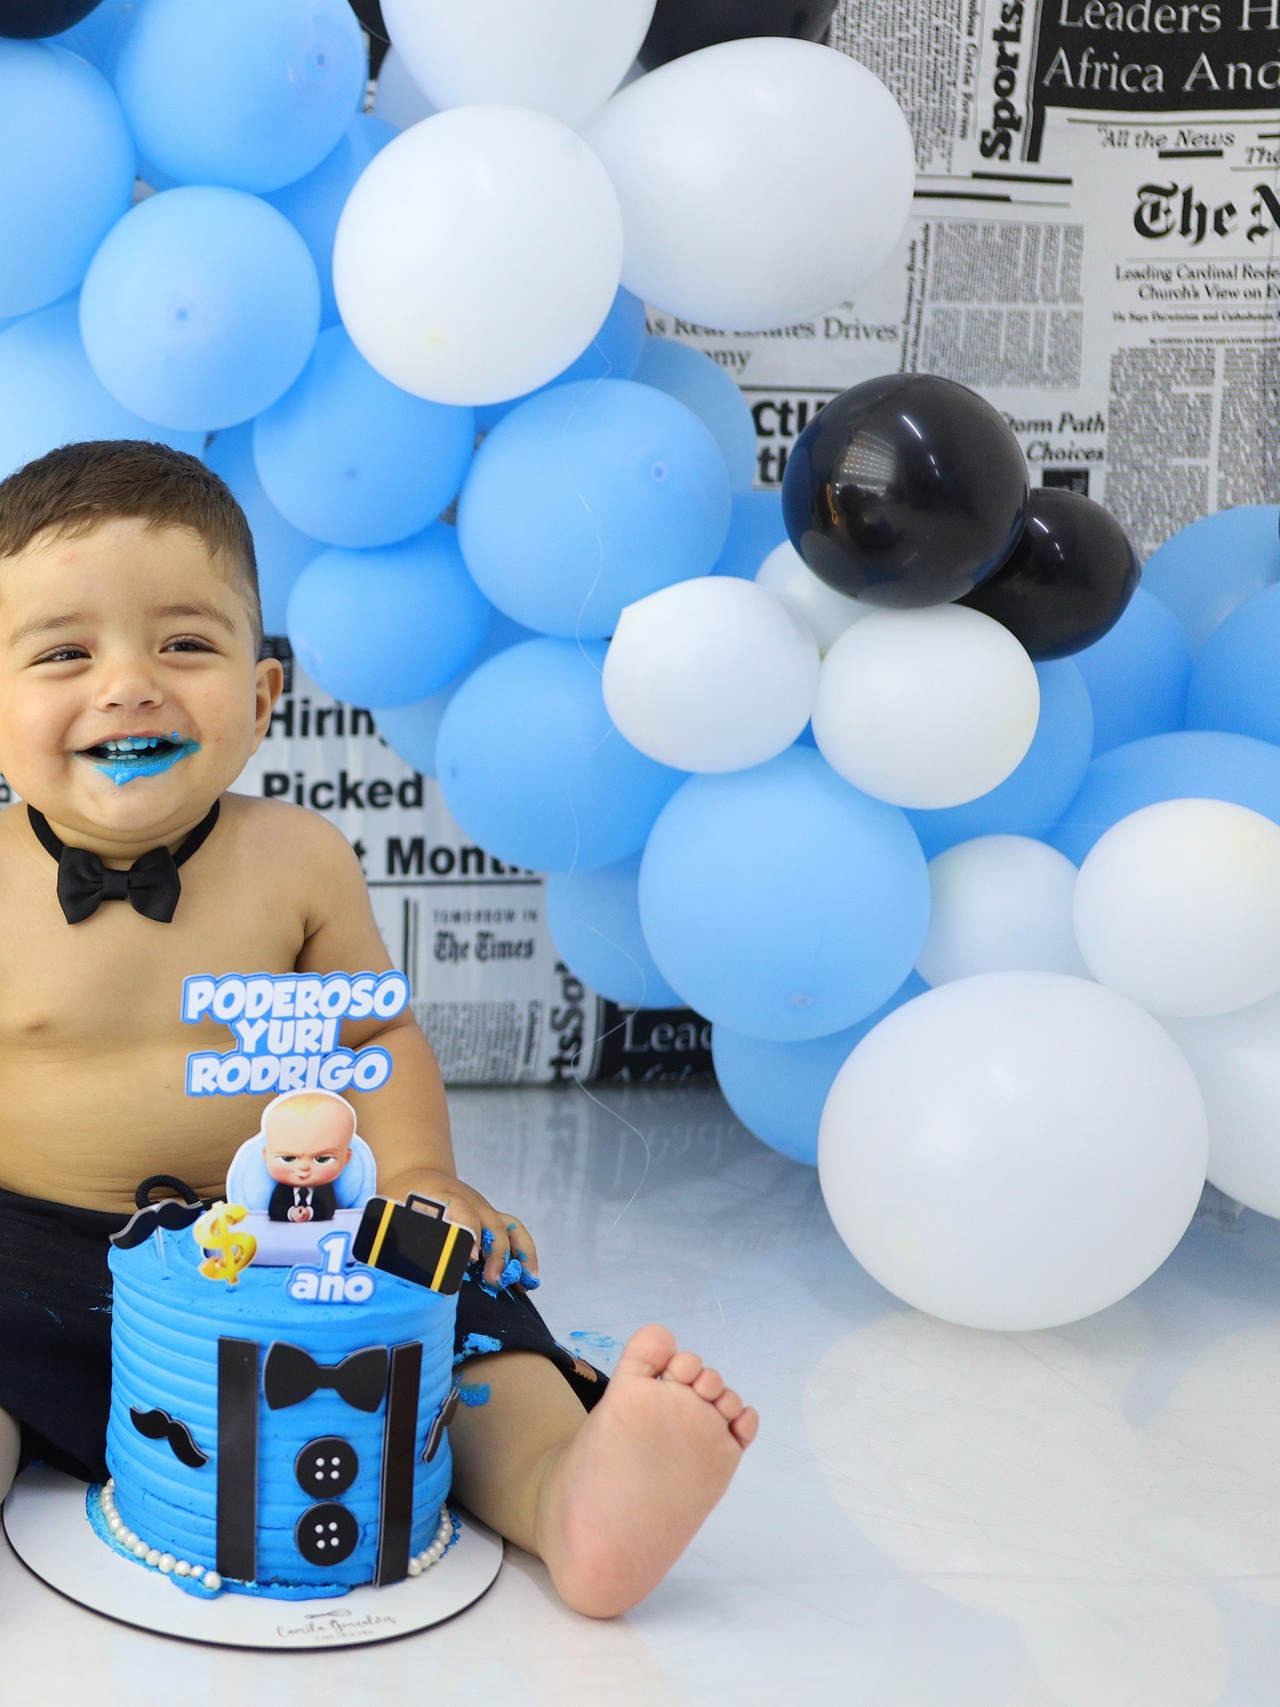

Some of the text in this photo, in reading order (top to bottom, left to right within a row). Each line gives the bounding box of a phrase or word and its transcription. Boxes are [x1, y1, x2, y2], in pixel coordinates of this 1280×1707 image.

[1058, 0, 1221, 34] Leaders
[979, 2, 1023, 161] Sports
[1041, 47, 1164, 93] Africa
[1133, 129, 1169, 148] the
[1173, 128, 1236, 148] News
[1133, 179, 1239, 246] The
[1115, 263, 1173, 284] Leading
[1176, 262, 1238, 281] Cardinal
[1203, 281, 1240, 300] View
[1242, 288, 1262, 300] on
[823, 315, 900, 342] Drives
[1057, 410, 1105, 434] Path
[1025, 440, 1105, 462] Choices
[263, 767, 424, 811] Picked
[523, 909, 537, 922] IN
[434, 929, 535, 963] The Times
[185, 976, 408, 1021] PODEROSO
[234, 1018, 339, 1054] YURI
[190, 1054, 388, 1094] RODRIGO
[321, 1233, 351, 1274] 1
[289, 1271, 375, 1302] ano
